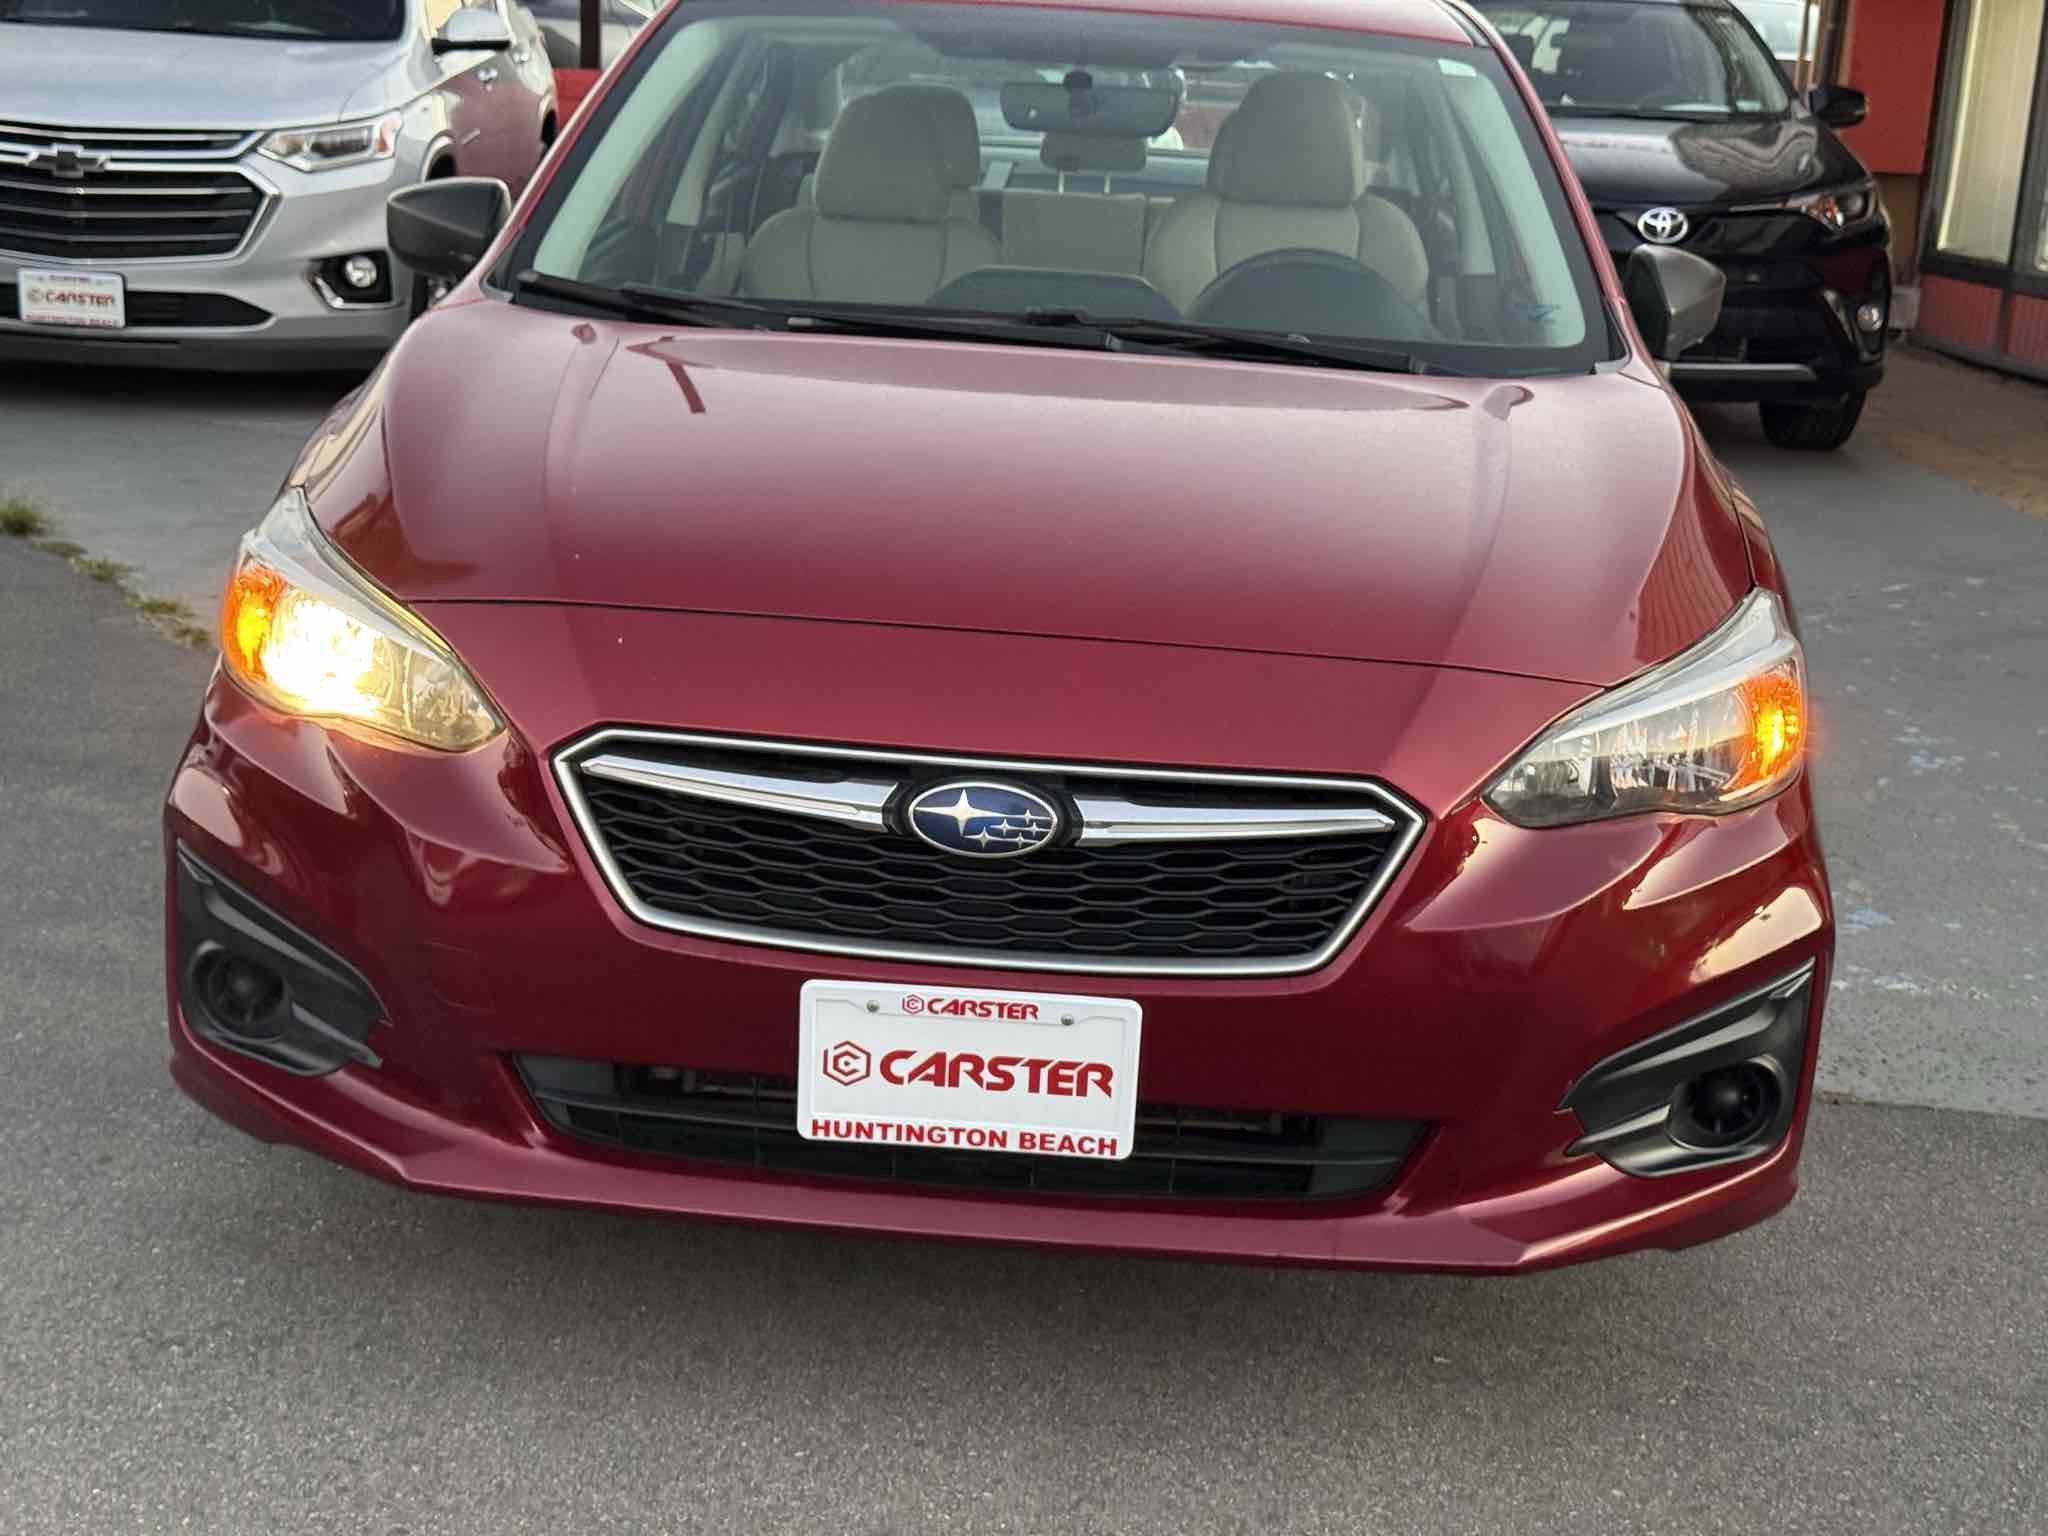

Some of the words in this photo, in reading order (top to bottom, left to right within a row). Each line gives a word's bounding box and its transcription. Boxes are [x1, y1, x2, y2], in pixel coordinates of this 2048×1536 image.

[927, 997, 1039, 1020] CARSTER
[880, 1049, 1114, 1099] CARSTER
[811, 1119, 1008, 1148] HUNTINGTON
[1018, 1132, 1118, 1156] BEACH
